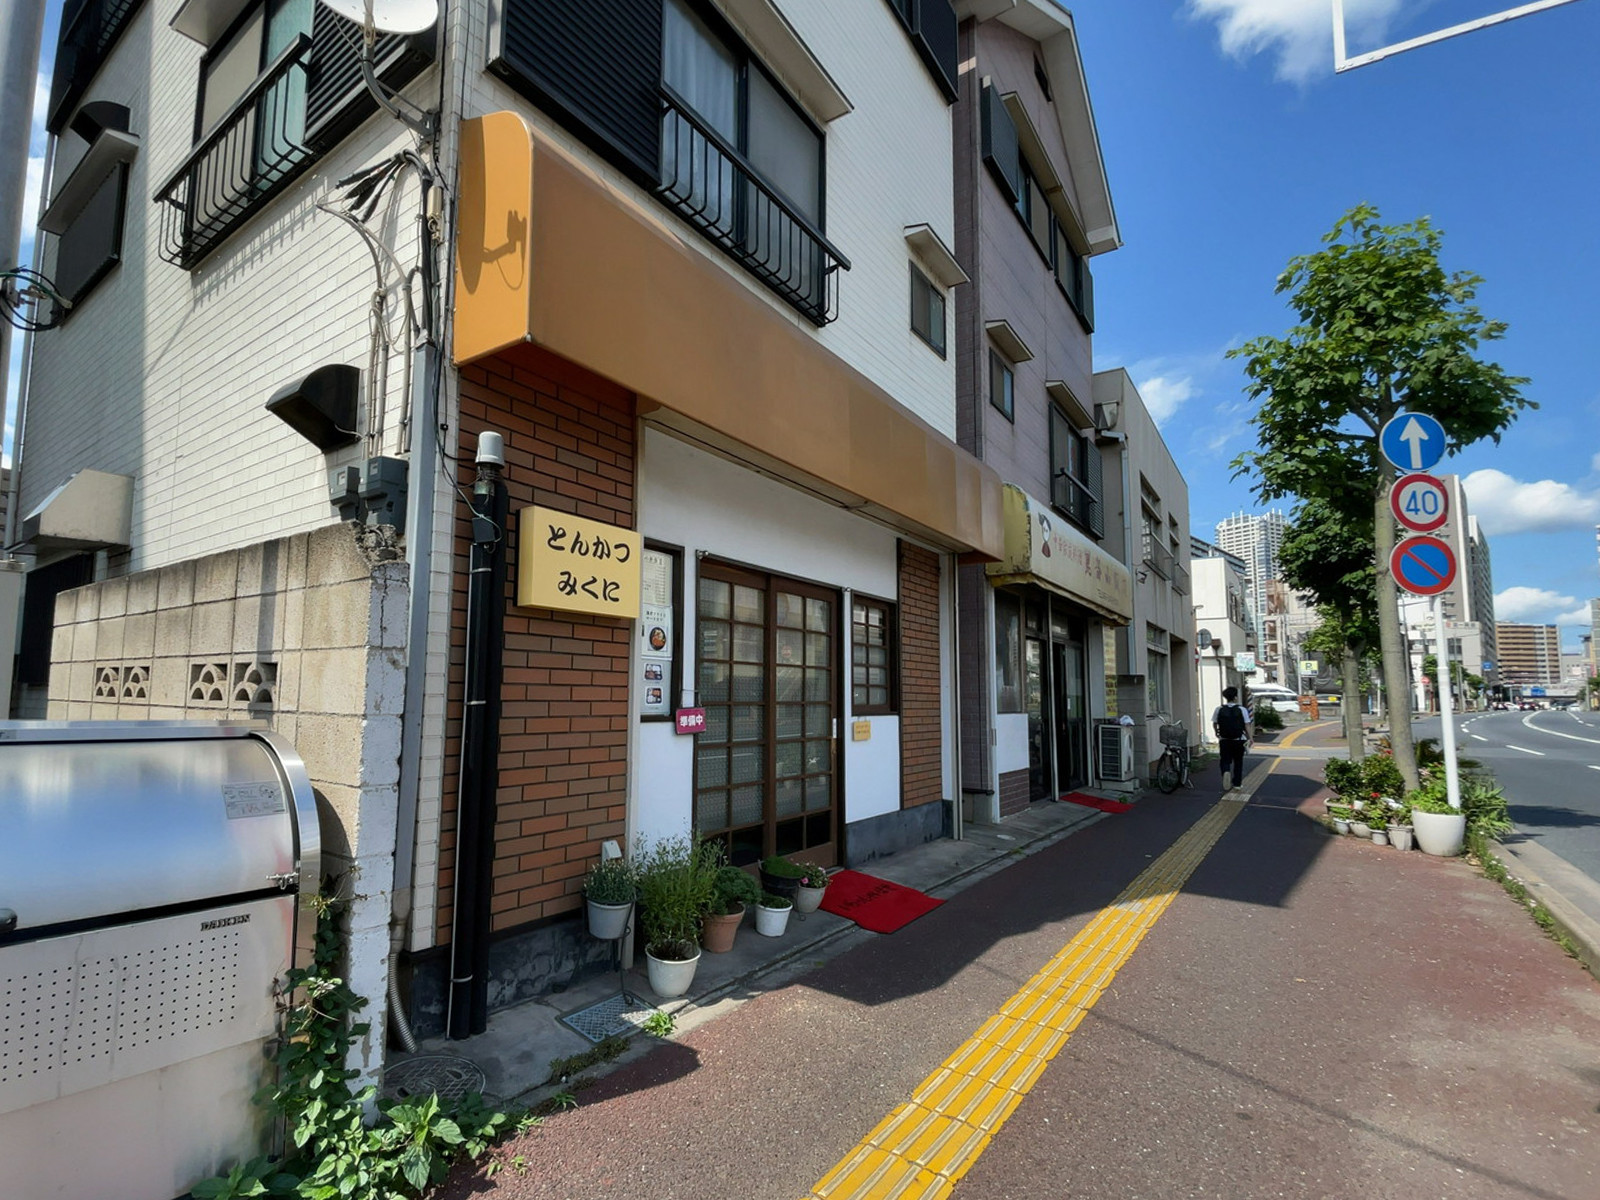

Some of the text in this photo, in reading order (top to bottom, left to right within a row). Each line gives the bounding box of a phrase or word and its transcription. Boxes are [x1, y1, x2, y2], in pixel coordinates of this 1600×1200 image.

[1405, 490, 1438, 515] 40
[547, 524, 630, 563] とんかつ
[557, 571, 621, 602] みくに
[680, 714, 703, 727] 準備中
